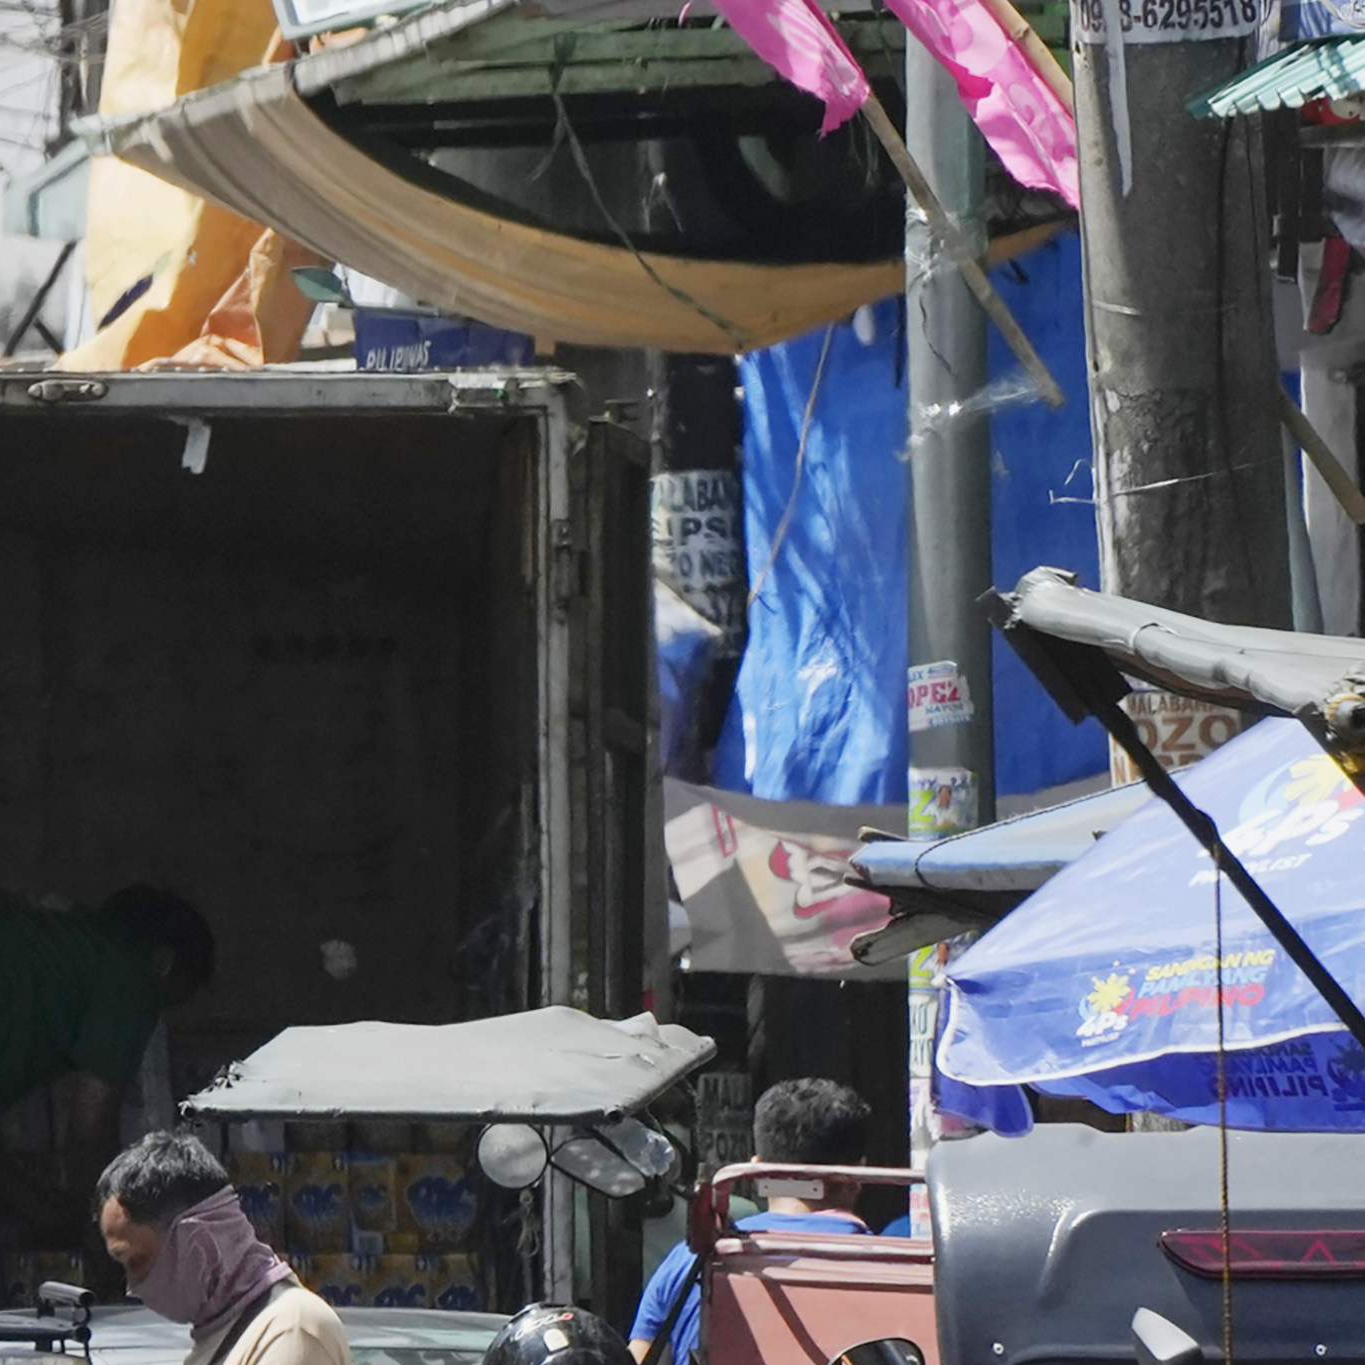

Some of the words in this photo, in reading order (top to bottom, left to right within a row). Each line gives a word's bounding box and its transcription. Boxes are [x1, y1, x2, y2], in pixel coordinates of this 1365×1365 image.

[1138, 714, 1240, 753] OZO
[1242, 949, 1277, 967] NG
[1076, 1011, 1130, 1038] 4Ps
